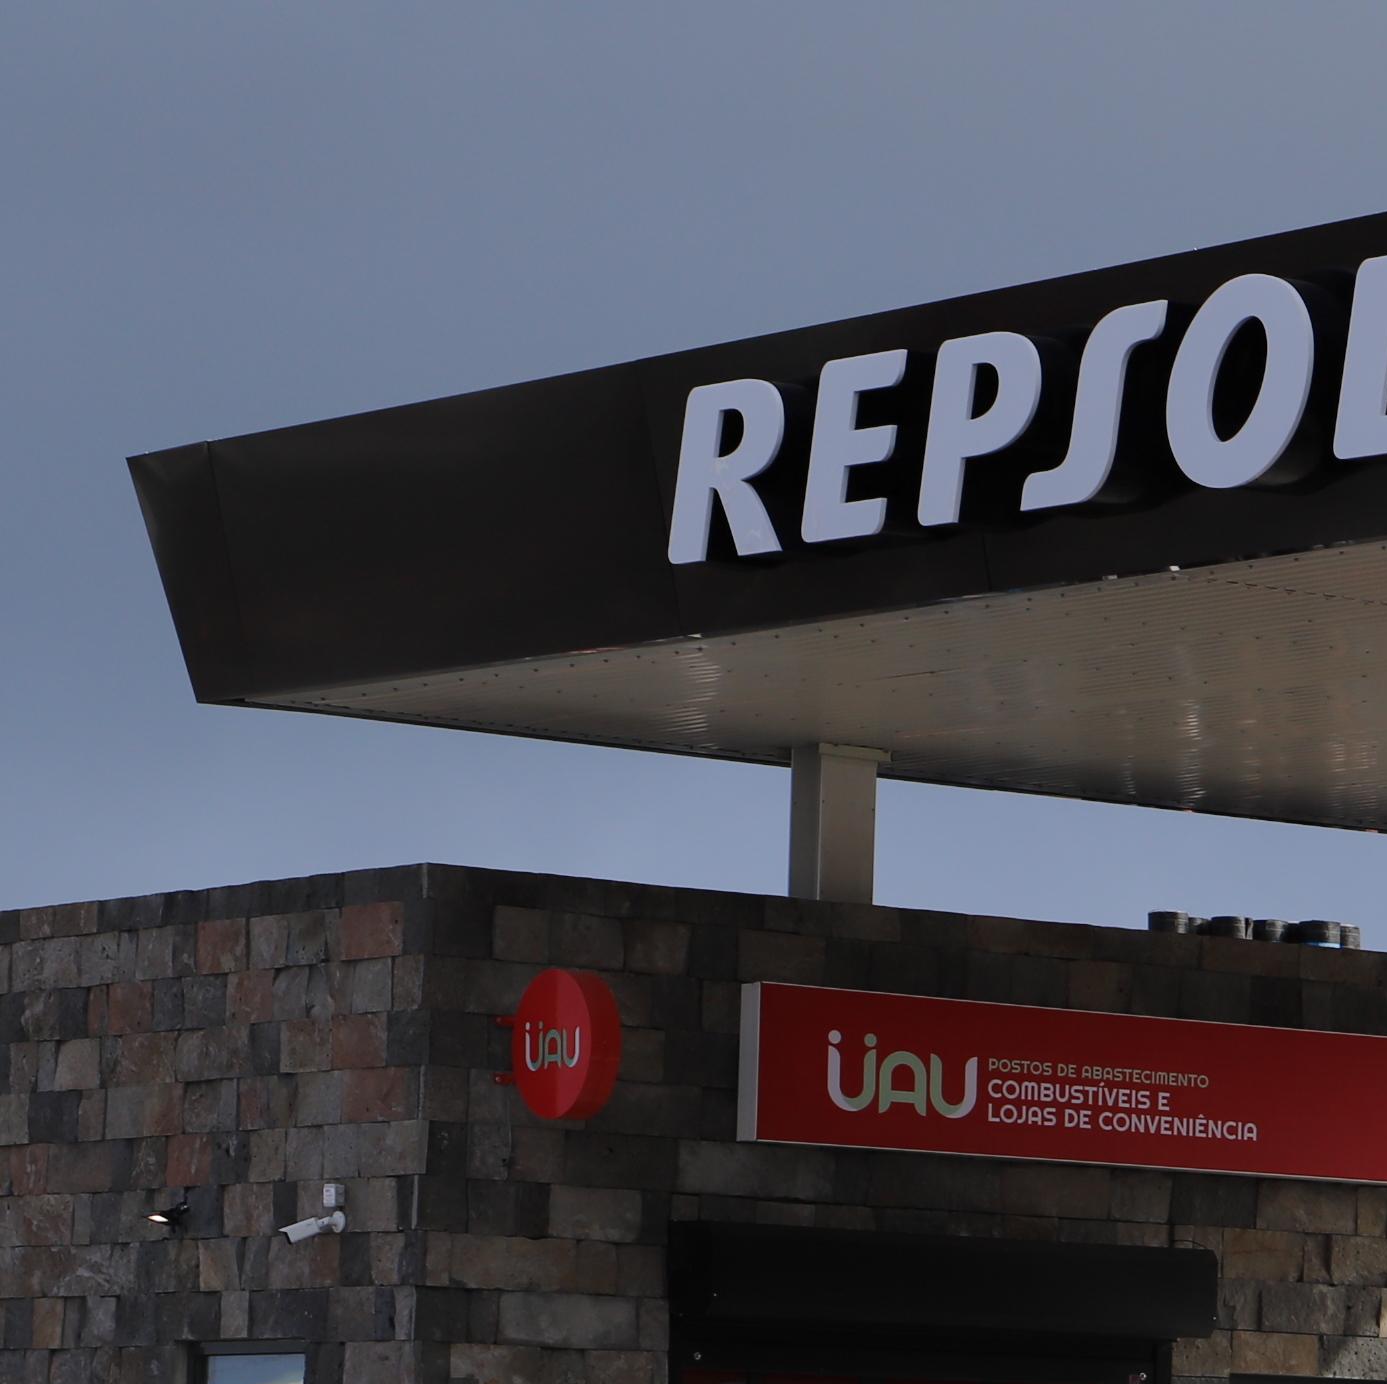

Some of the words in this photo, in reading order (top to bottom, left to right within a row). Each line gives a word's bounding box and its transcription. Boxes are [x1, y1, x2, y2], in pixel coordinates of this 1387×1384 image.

[988, 1058, 1053, 1076] POSTOS
[1057, 1063, 1077, 1078] DE
[1081, 1065, 1209, 1088] ABASTECIMENTO
[987, 1078, 1151, 1109] COMBUSTÍVEIS
[1158, 1092, 1170, 1111] E
[987, 1103, 1057, 1127] LOJAS
[1064, 1108, 1092, 1129] DE
[1099, 1111, 1258, 1141] CONVENIÊNCIA
